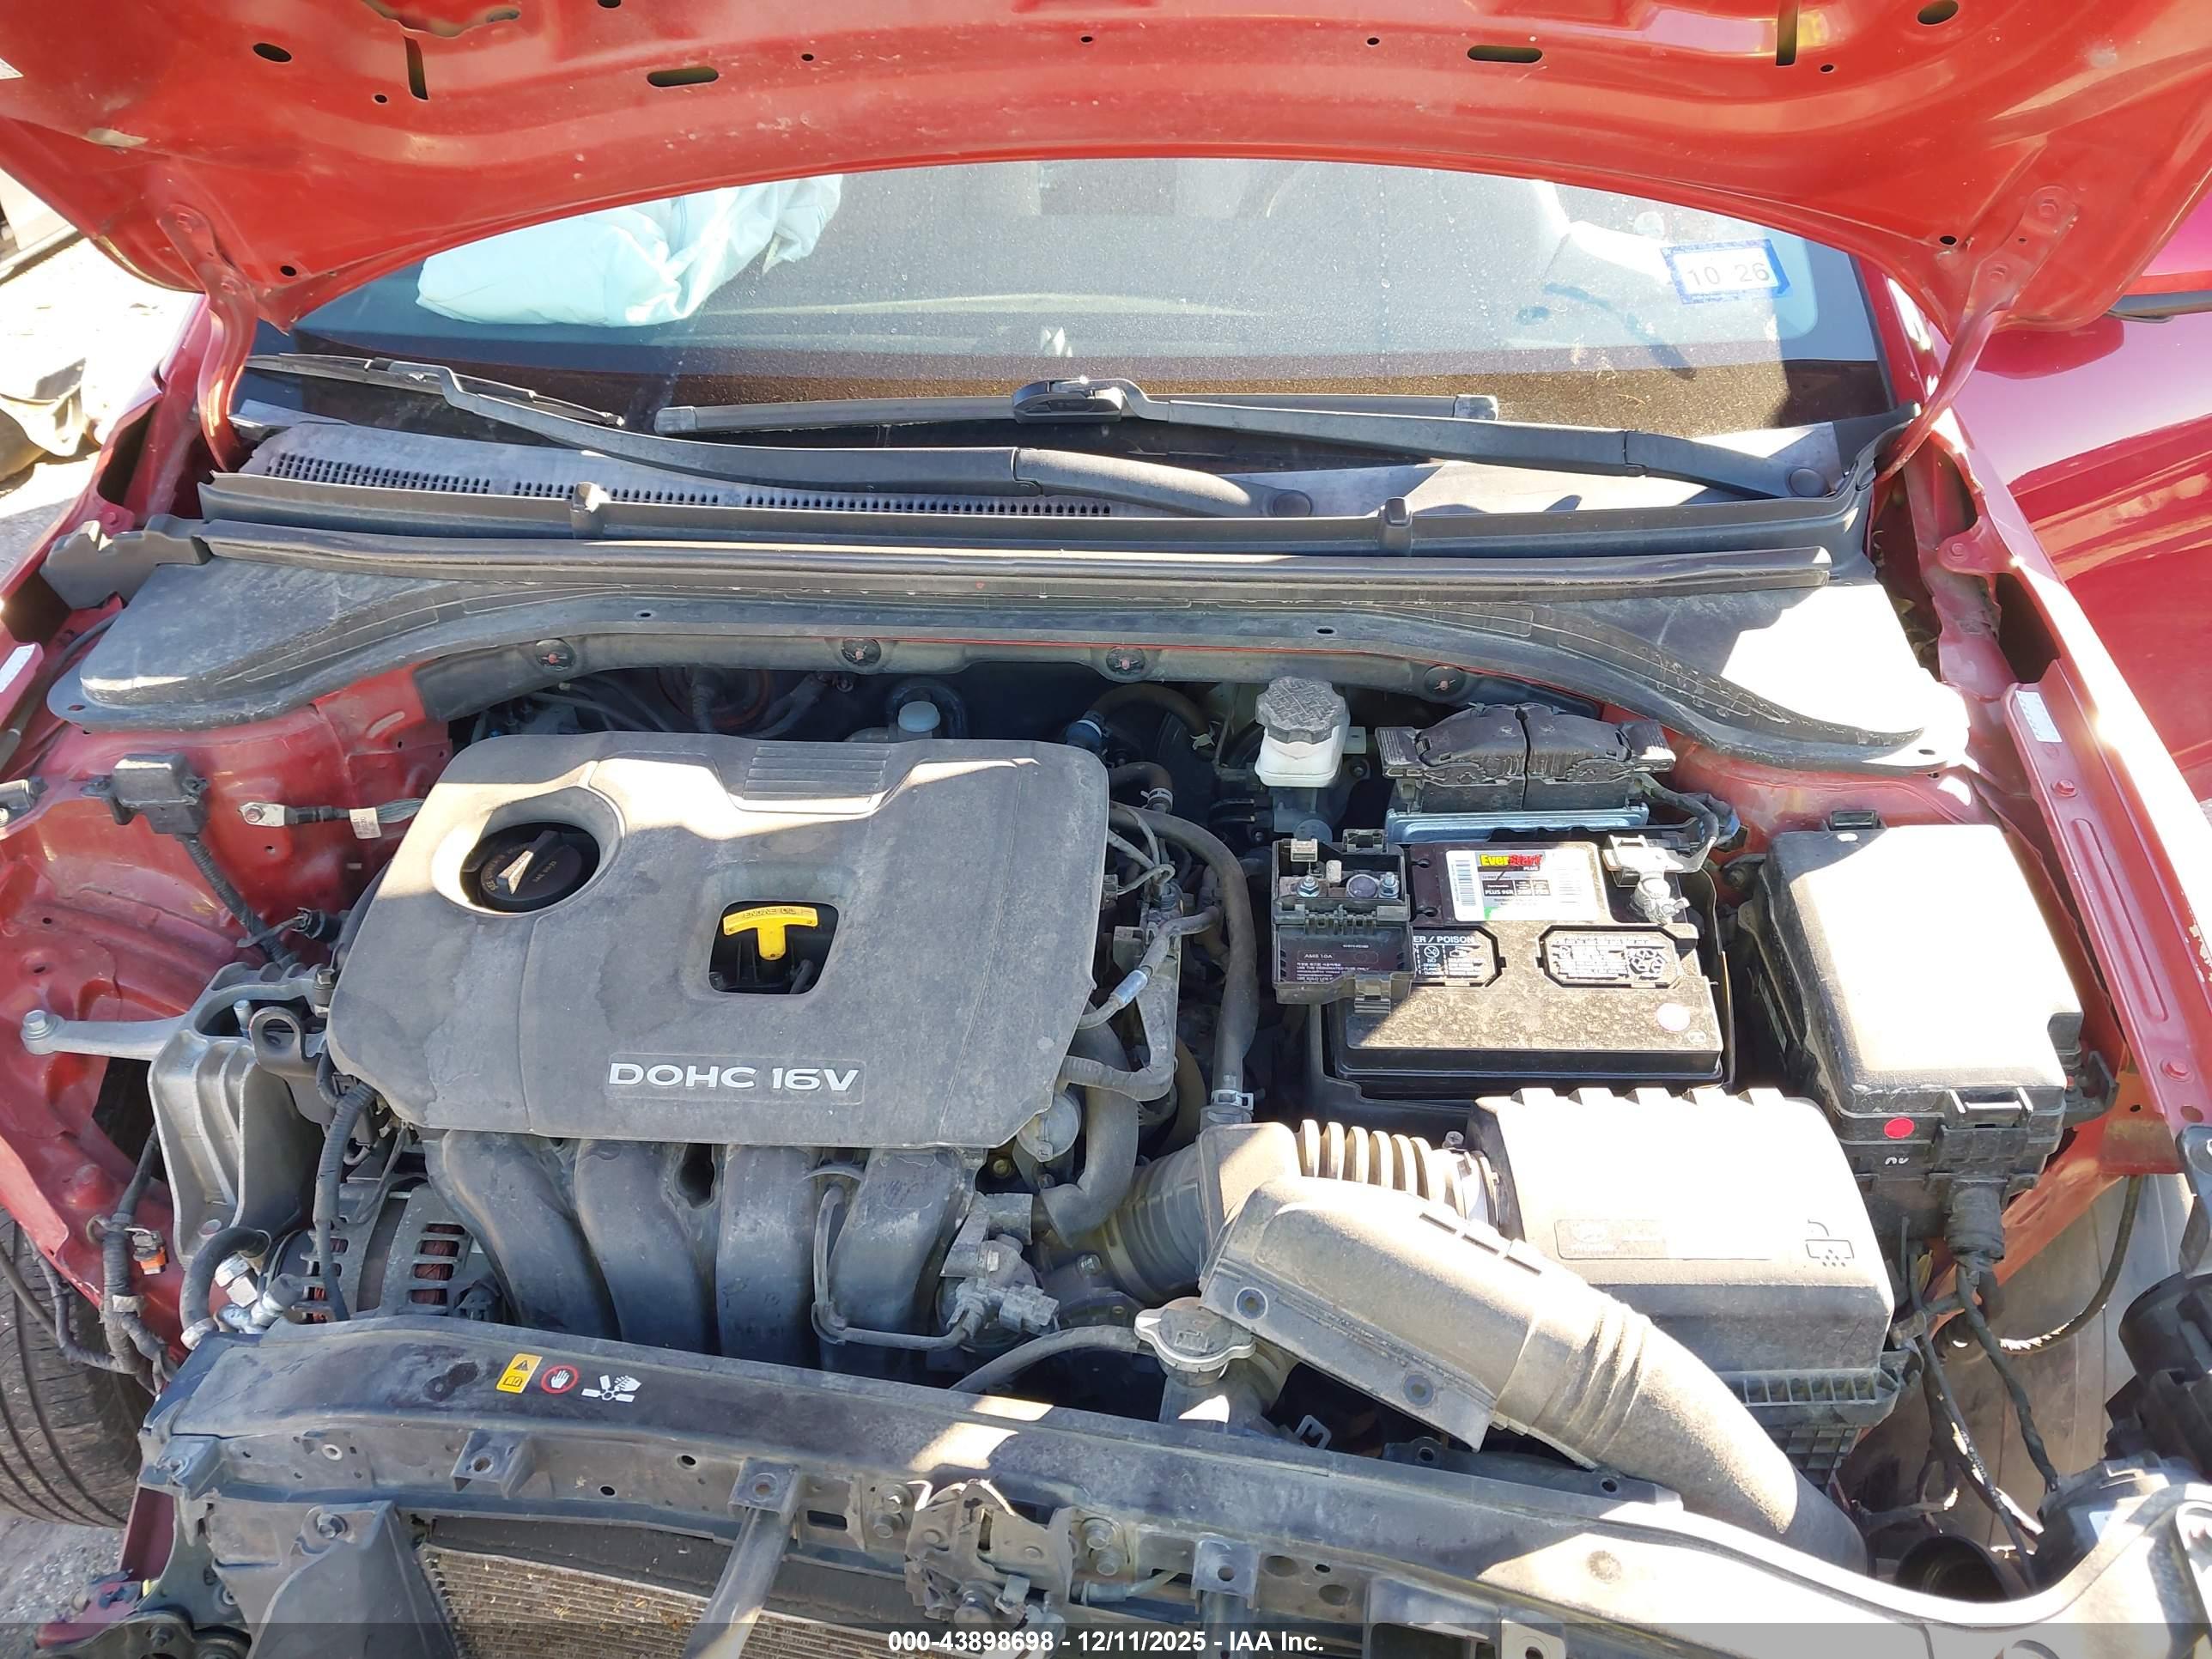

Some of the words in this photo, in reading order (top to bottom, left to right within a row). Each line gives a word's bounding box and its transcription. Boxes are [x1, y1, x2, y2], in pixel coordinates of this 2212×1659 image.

[1688, 266, 1722, 286] 10
[1734, 262, 1771, 283] 26
[1480, 854, 1543, 866] EverStart
[743, 908, 777, 919] ENGINE
[608, 1062, 757, 1089] DOHC
[772, 1067, 860, 1092] 16V
